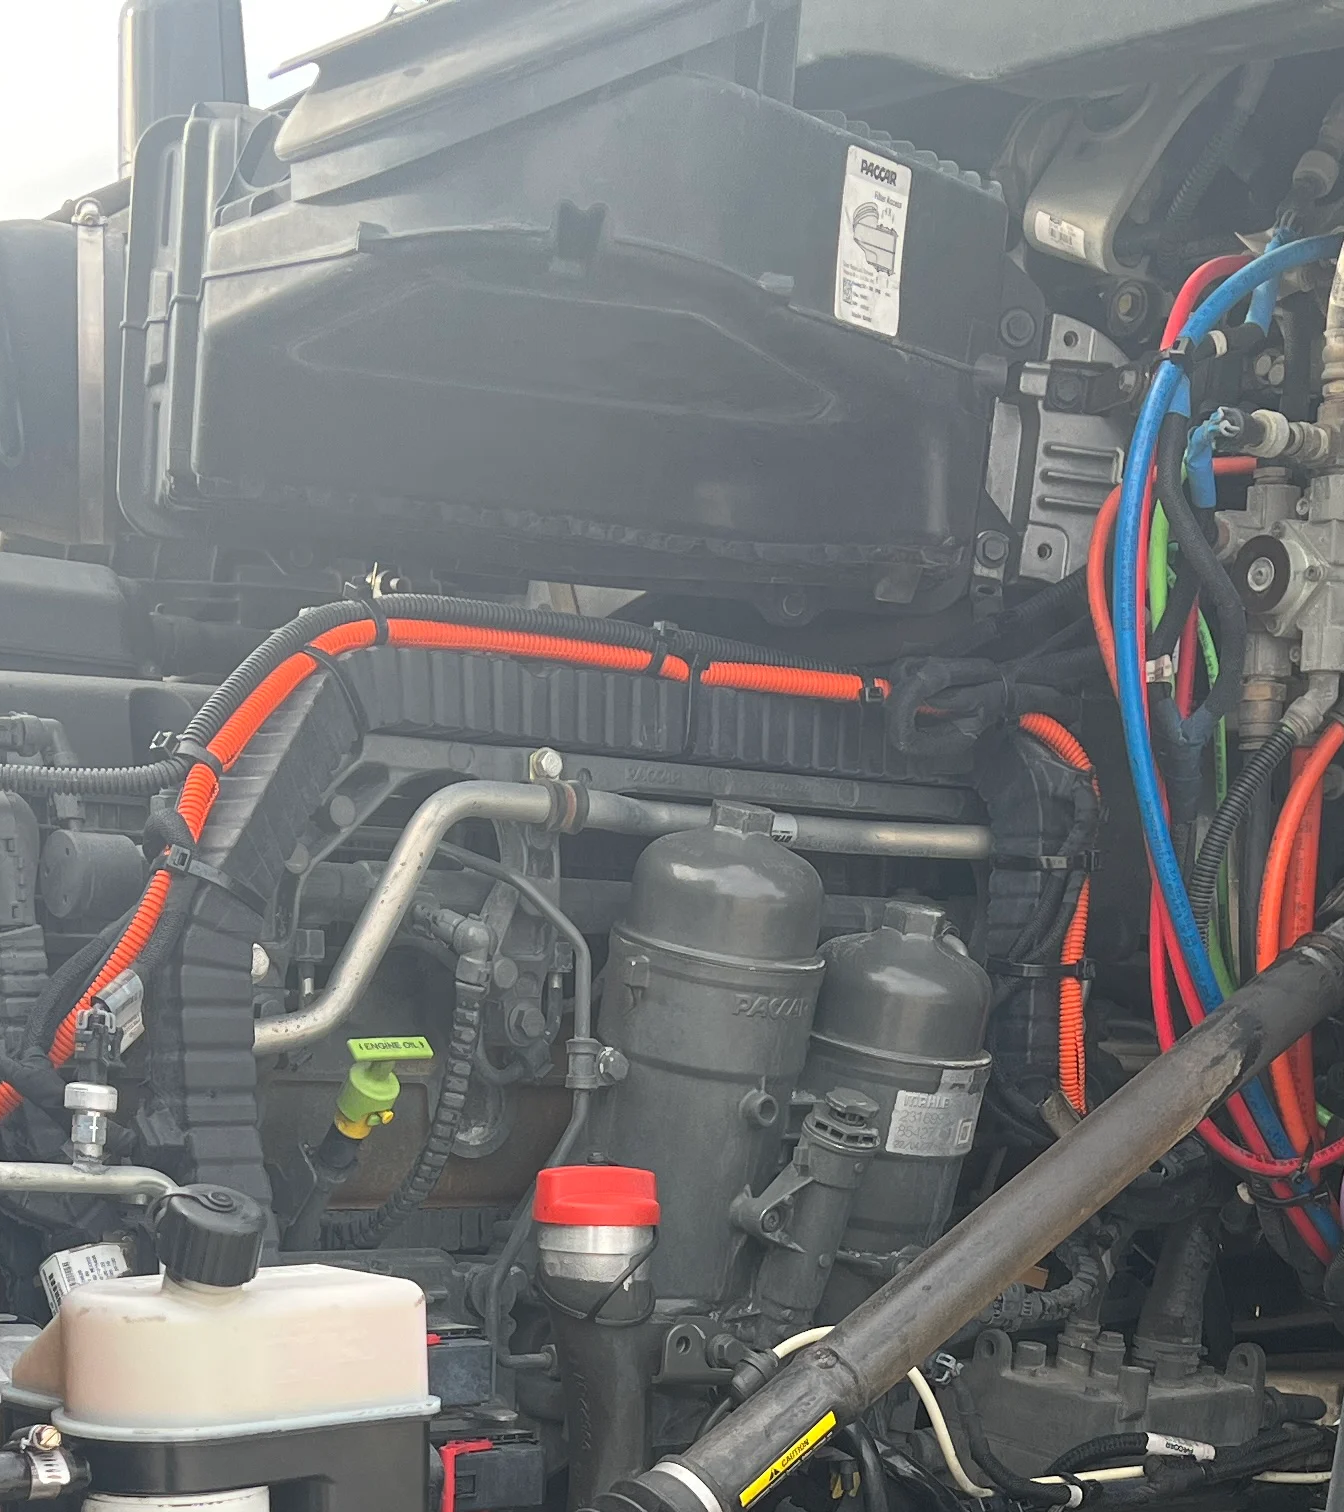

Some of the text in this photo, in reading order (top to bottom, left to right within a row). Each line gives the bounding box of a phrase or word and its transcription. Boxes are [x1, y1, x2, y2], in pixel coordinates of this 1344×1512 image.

[860, 158, 897, 187] PACCAR
[364, 1041, 419, 1051] ENGINE OIL
[781, 1438, 810, 1468] CAUTION
